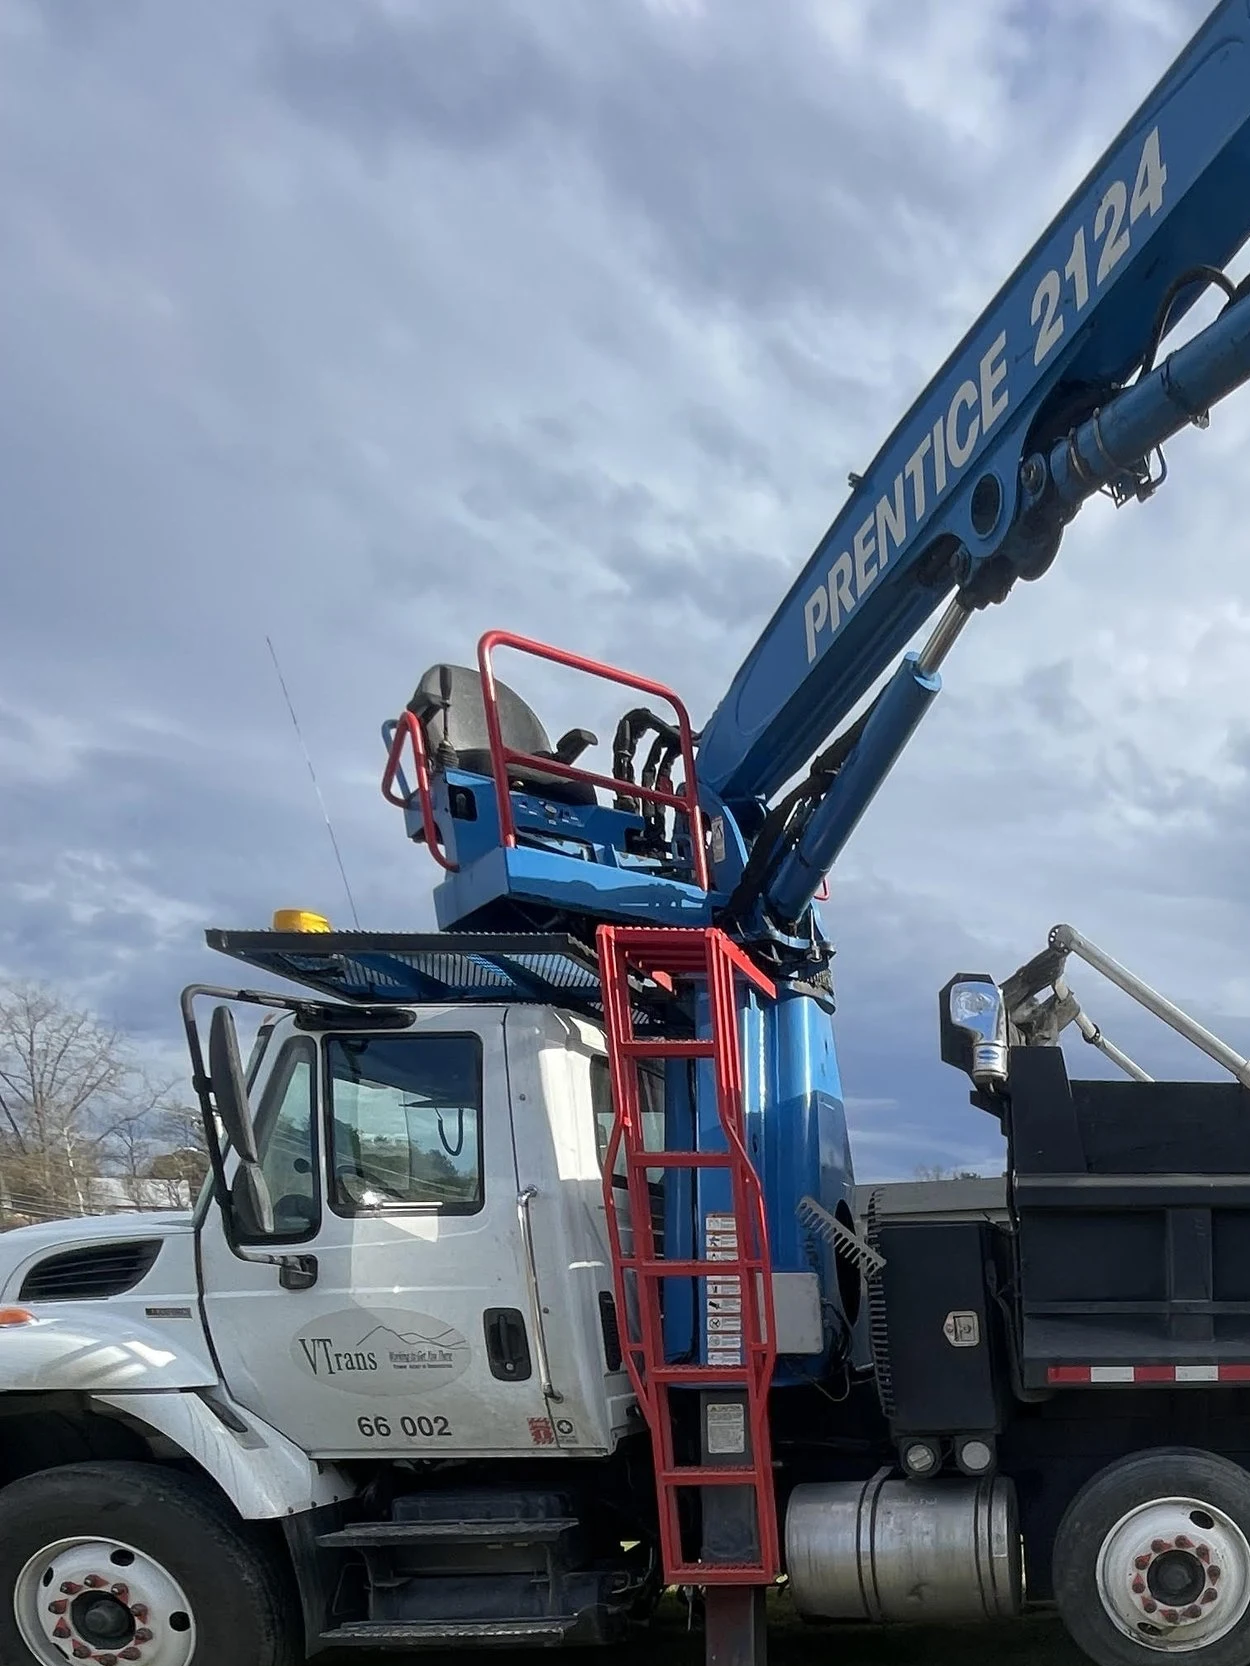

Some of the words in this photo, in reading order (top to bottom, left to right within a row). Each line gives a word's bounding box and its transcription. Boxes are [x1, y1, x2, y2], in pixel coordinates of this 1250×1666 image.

[802, 329, 1008, 665] PRENTICE
[1031, 125, 1167, 367] 2124
[299, 1338, 378, 1375] VTrans
[357, 1416, 391, 1437] 66
[400, 1416, 453, 1437] 002
